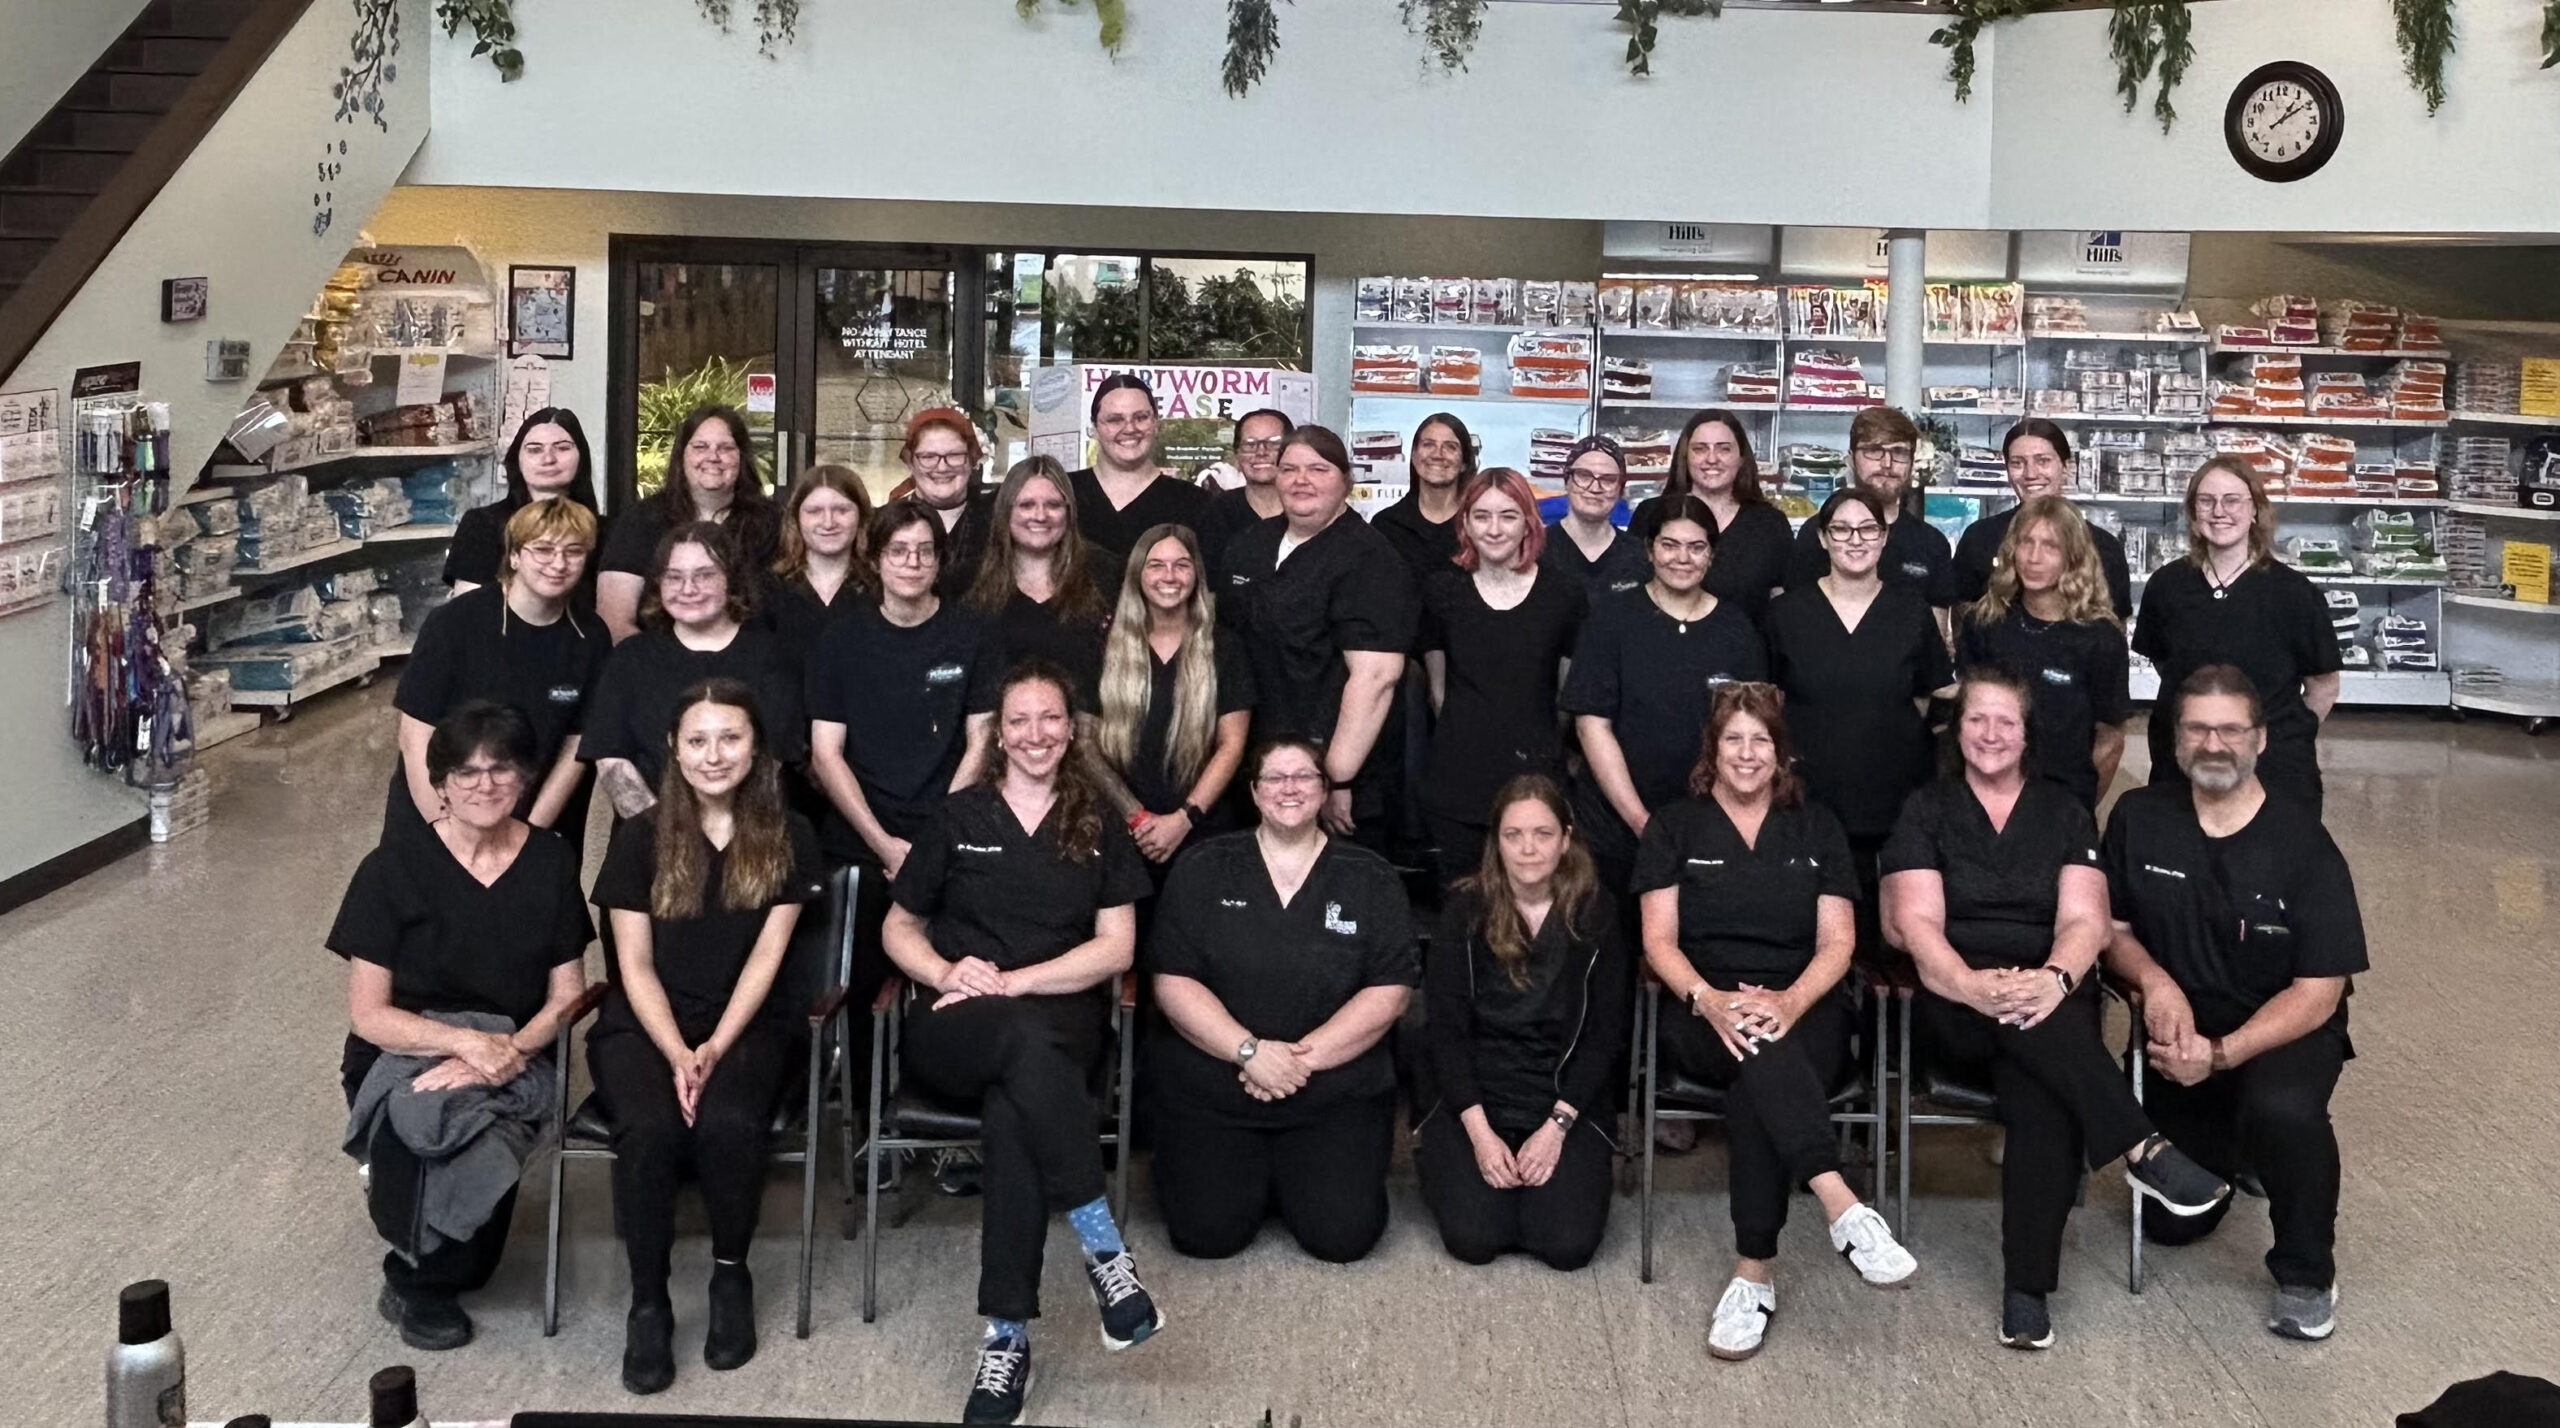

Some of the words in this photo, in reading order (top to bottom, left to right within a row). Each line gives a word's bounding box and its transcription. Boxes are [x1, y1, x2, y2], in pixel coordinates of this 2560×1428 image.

[377, 269, 456, 284] CANIN
[842, 326, 858, 336] NO
[842, 338, 889, 348] WITHOUT
[893, 339, 928, 348] HOTEL
[1084, 368, 1271, 395] HRTWORM
